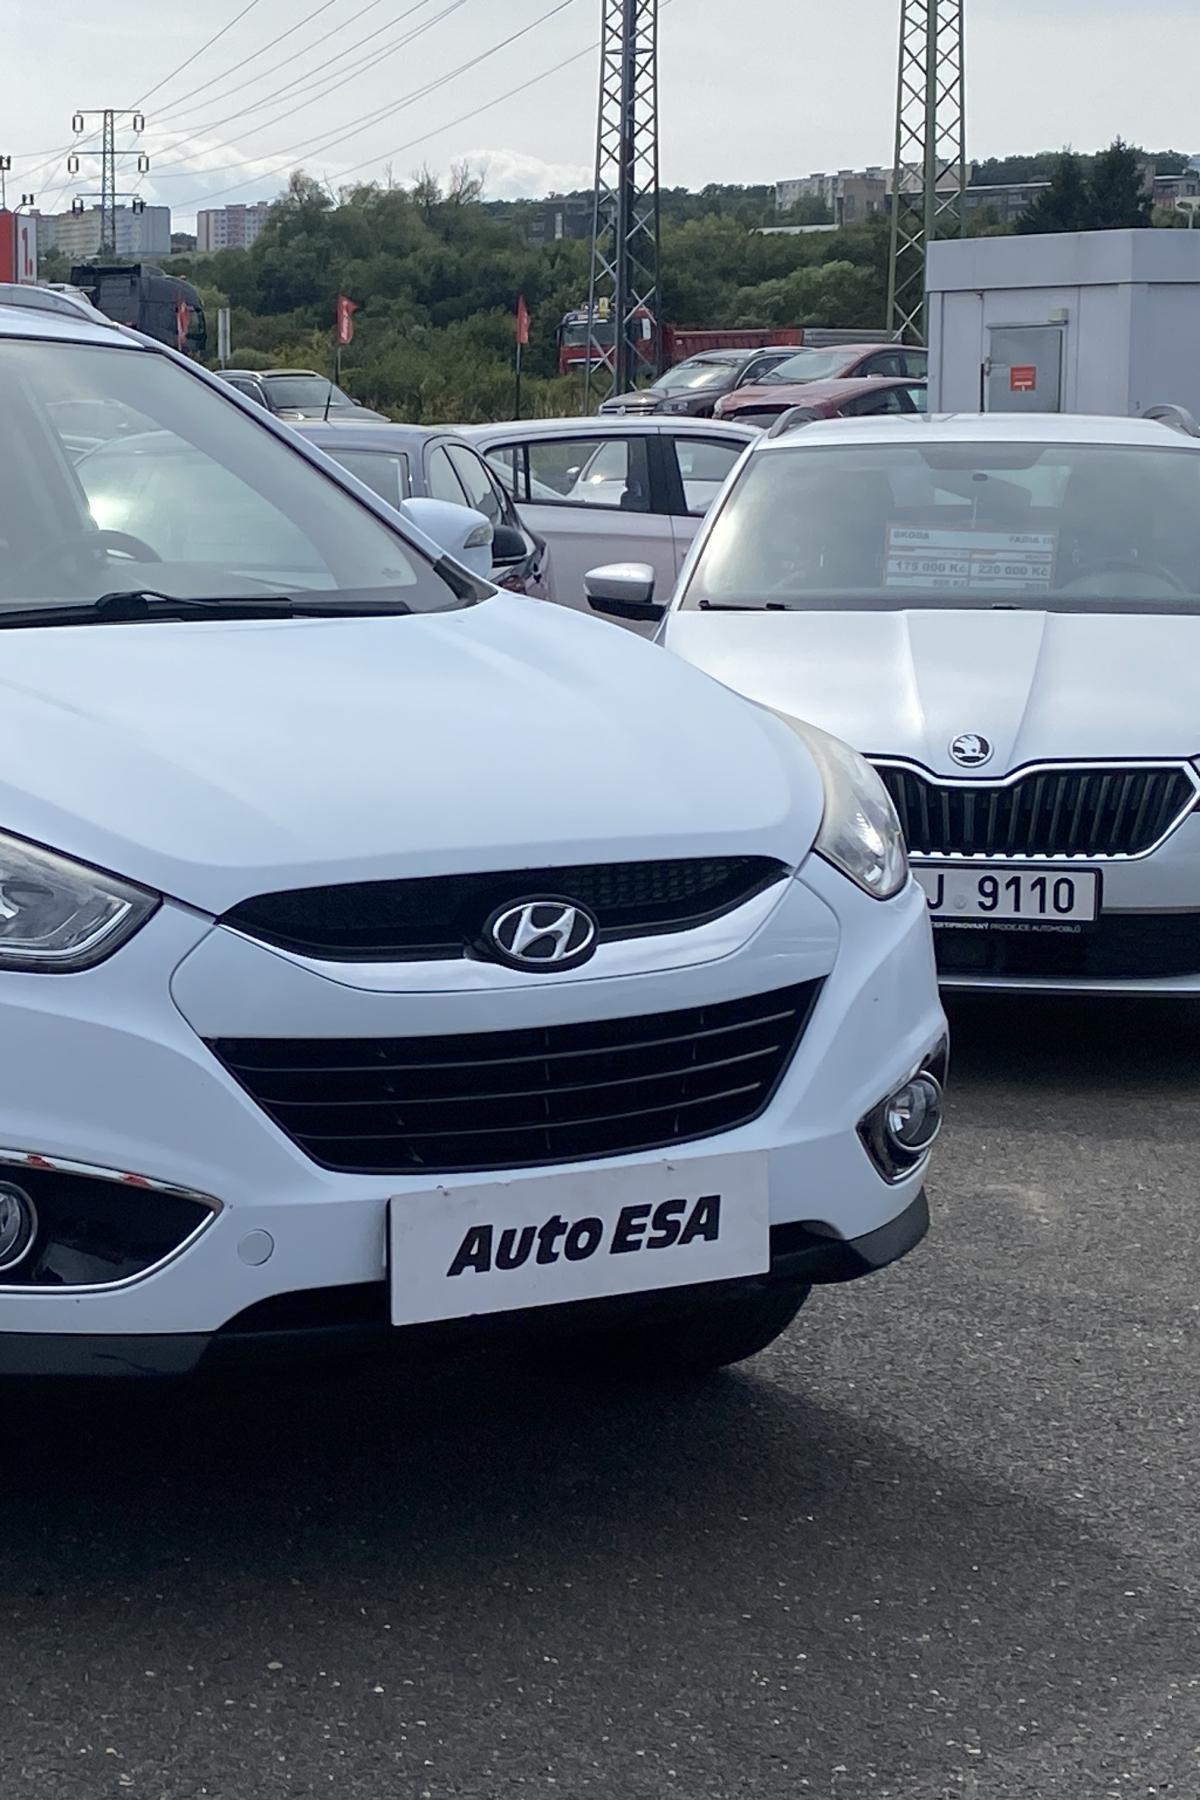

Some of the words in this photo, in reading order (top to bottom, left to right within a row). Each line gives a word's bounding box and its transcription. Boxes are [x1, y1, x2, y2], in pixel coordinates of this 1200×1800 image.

[978, 875, 1075, 914] 9110
[446, 1215, 604, 1277] Auto
[609, 1195, 721, 1255] ESA
